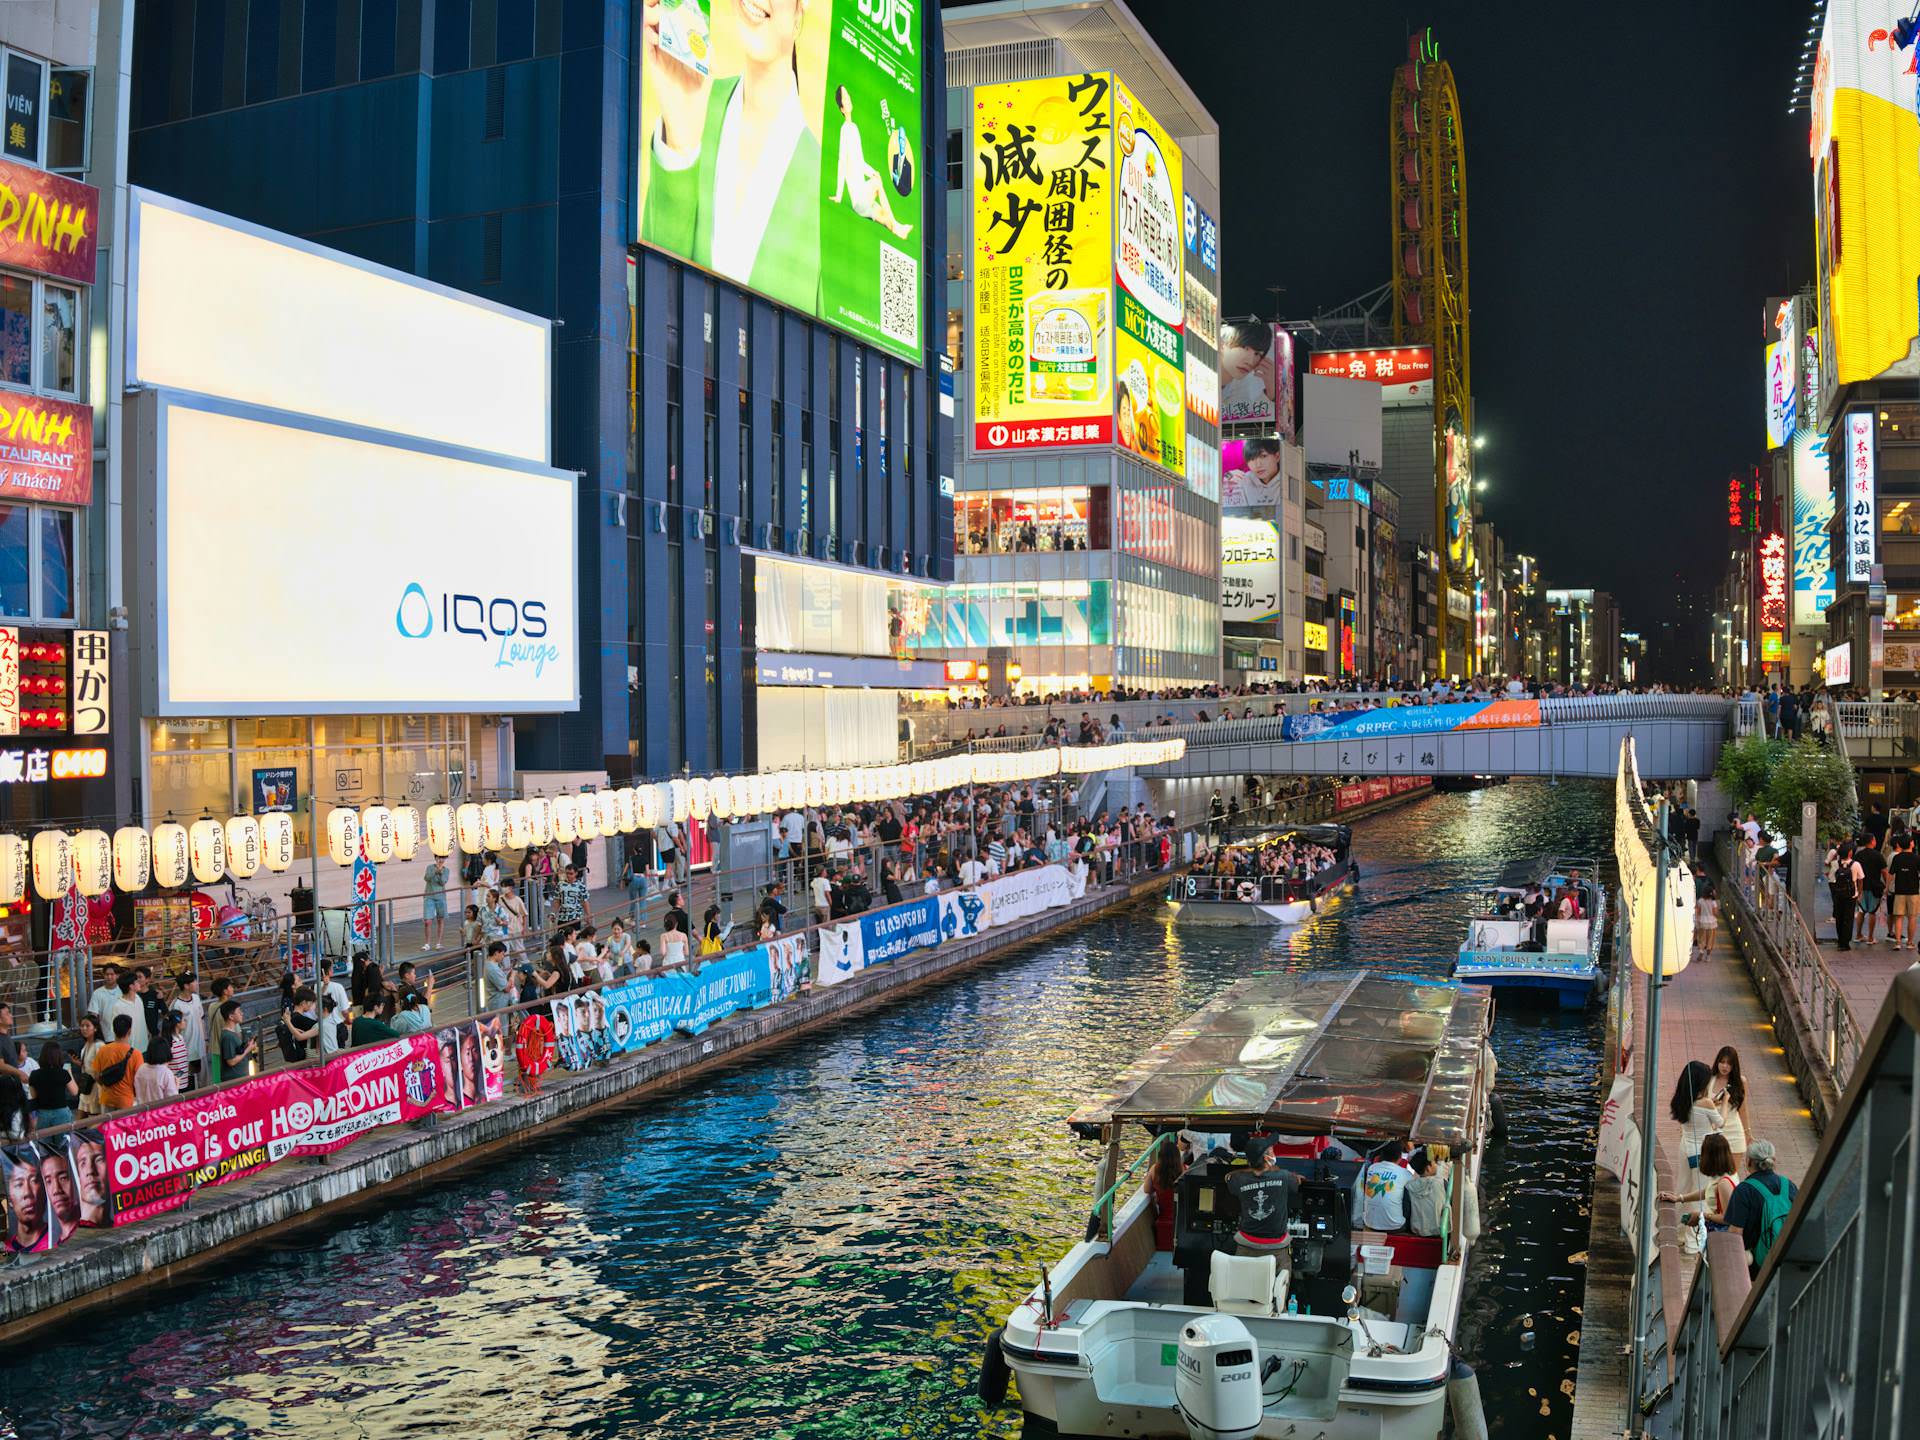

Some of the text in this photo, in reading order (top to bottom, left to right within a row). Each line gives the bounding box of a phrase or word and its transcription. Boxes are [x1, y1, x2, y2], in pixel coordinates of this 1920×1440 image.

[7, 94, 32, 116] VIÊN
[9, 122, 26, 148] 集
[980, 124, 1044, 254] 減少
[1041, 167, 1077, 290] 周囲径の
[1008, 266, 1025, 405] BMIが高めの方に
[1124, 306, 1145, 340] MCT
[1012, 424, 1100, 443] 山本漢方製薬
[1854, 500, 1871, 575] かに道楽
[443, 593, 547, 642] IQOS
[495, 628, 559, 678] Lounge
[77, 633, 106, 732] 串かつ
[1341, 752, 1435, 767] えびす橋
[212, 827, 222, 873] PABLO
[245, 826, 256, 870] PABLO
[280, 820, 290, 863] PABLO
[345, 816, 353, 857] PABLO
[110, 1104, 237, 1151] Welcome to Osaka
[114, 1073, 399, 1186] Osaka is our HOMETOWN
[195, 1164, 218, 1185] NO
[1220, 1371, 1252, 1383] 200
